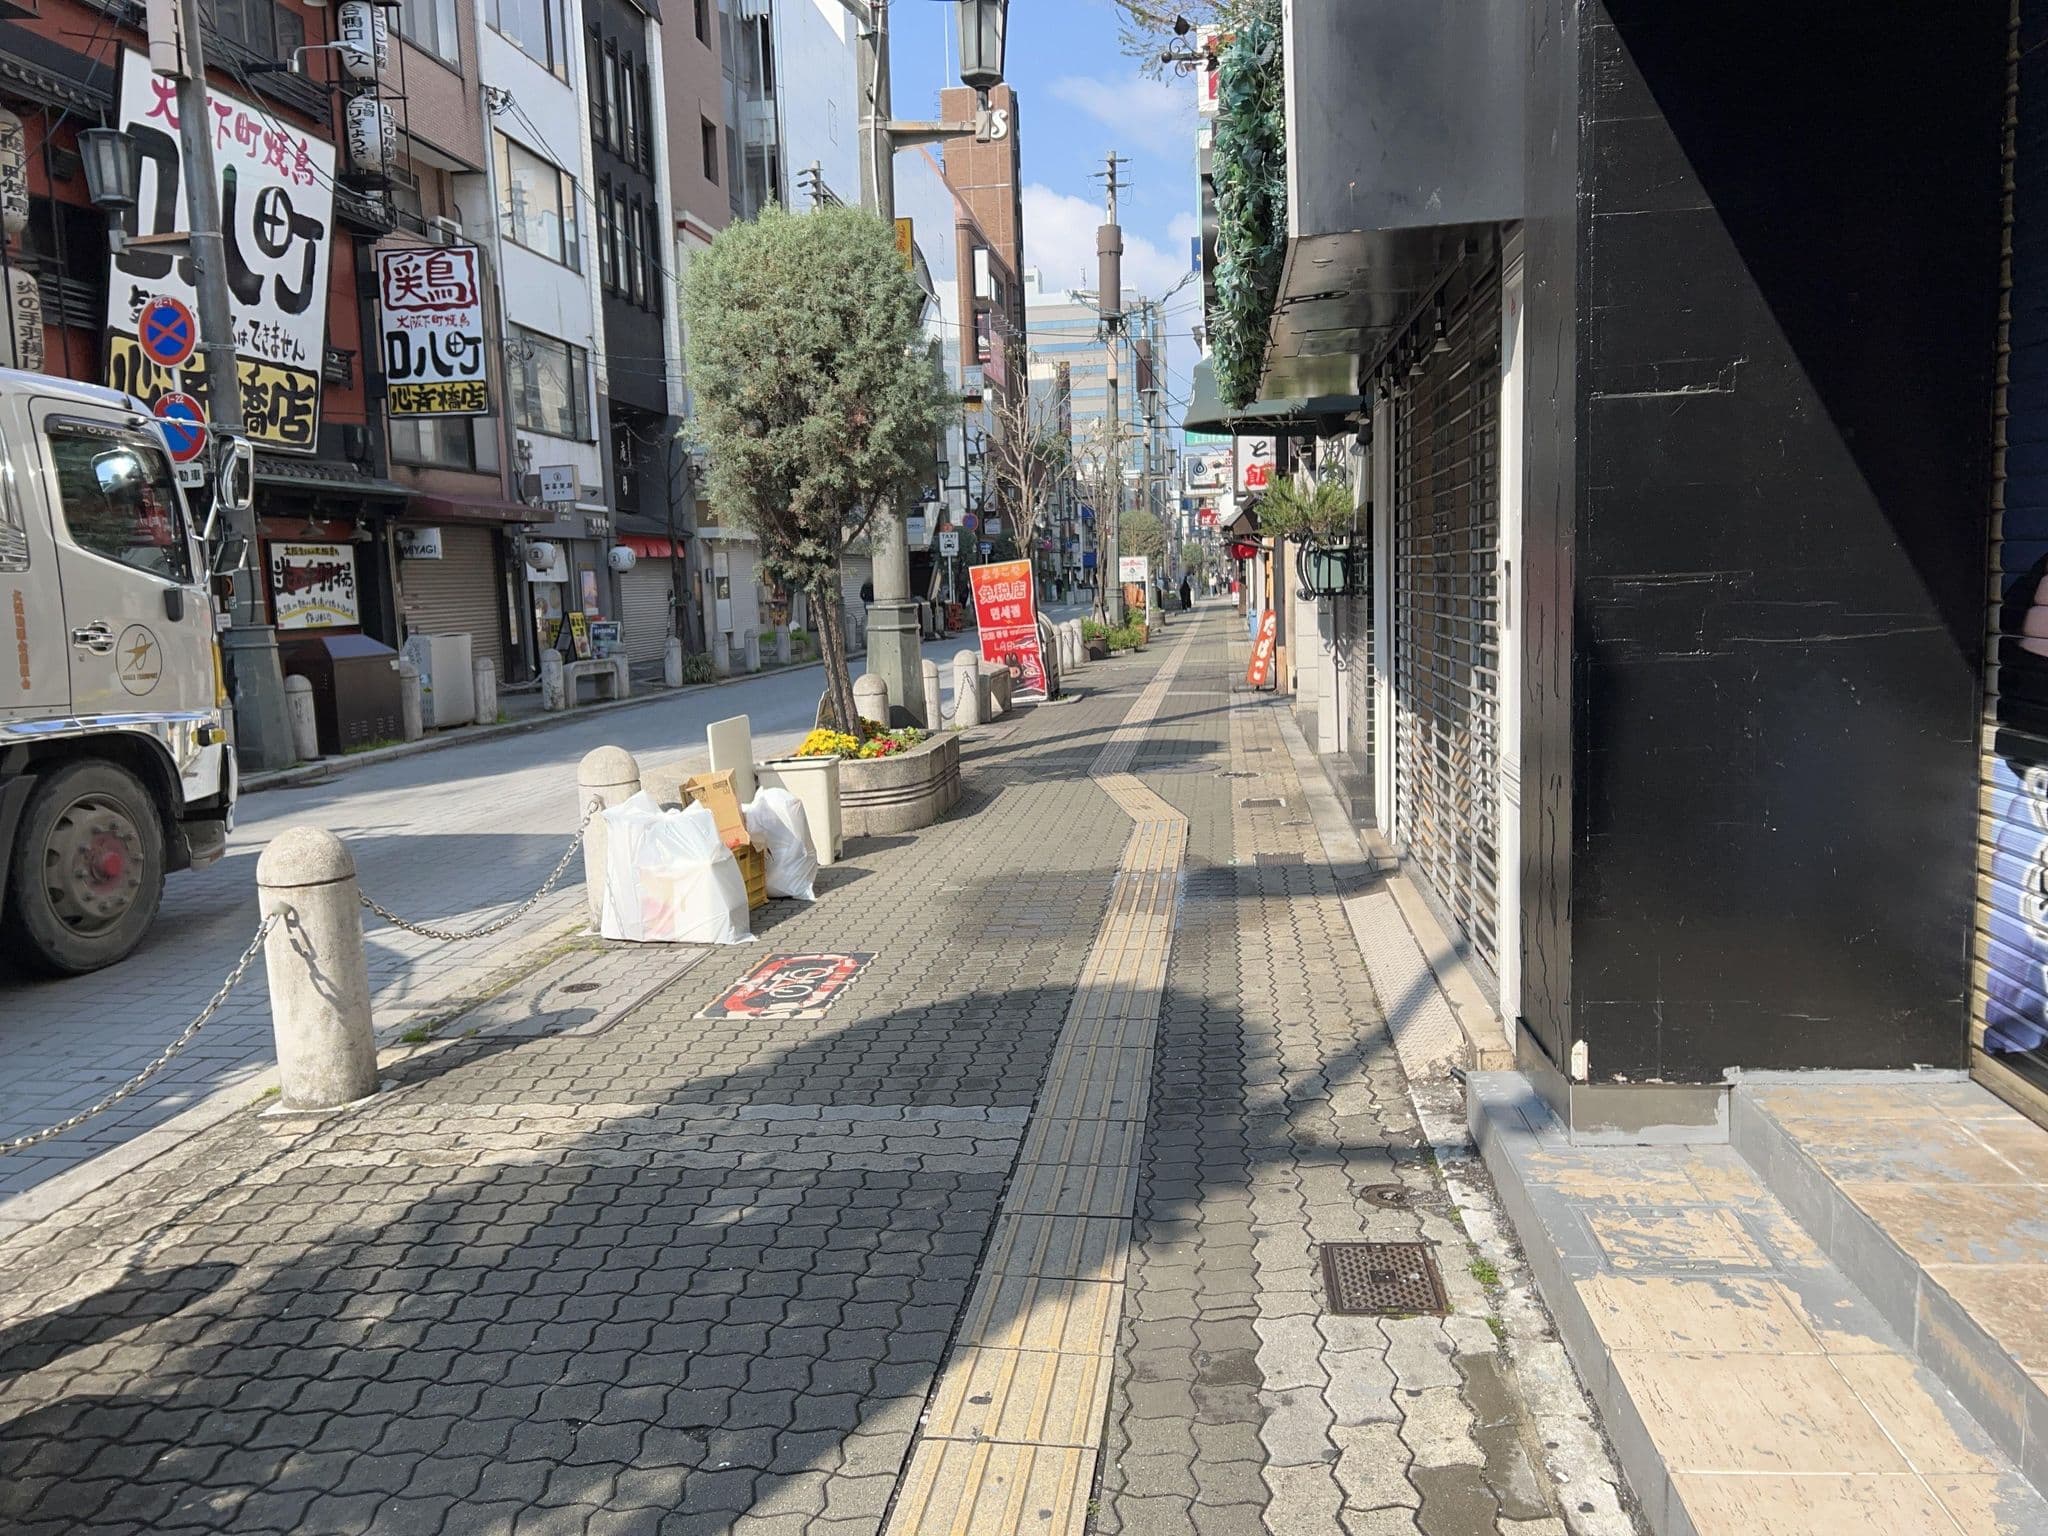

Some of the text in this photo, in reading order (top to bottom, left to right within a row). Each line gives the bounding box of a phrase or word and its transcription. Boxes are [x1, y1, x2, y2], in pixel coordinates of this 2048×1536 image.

[341, 3, 369, 68] 合鴨ロス
[145, 77, 313, 186] 大下町焼鳥
[177, 469, 201, 482] 動車
[978, 580, 1027, 605] 免税店
